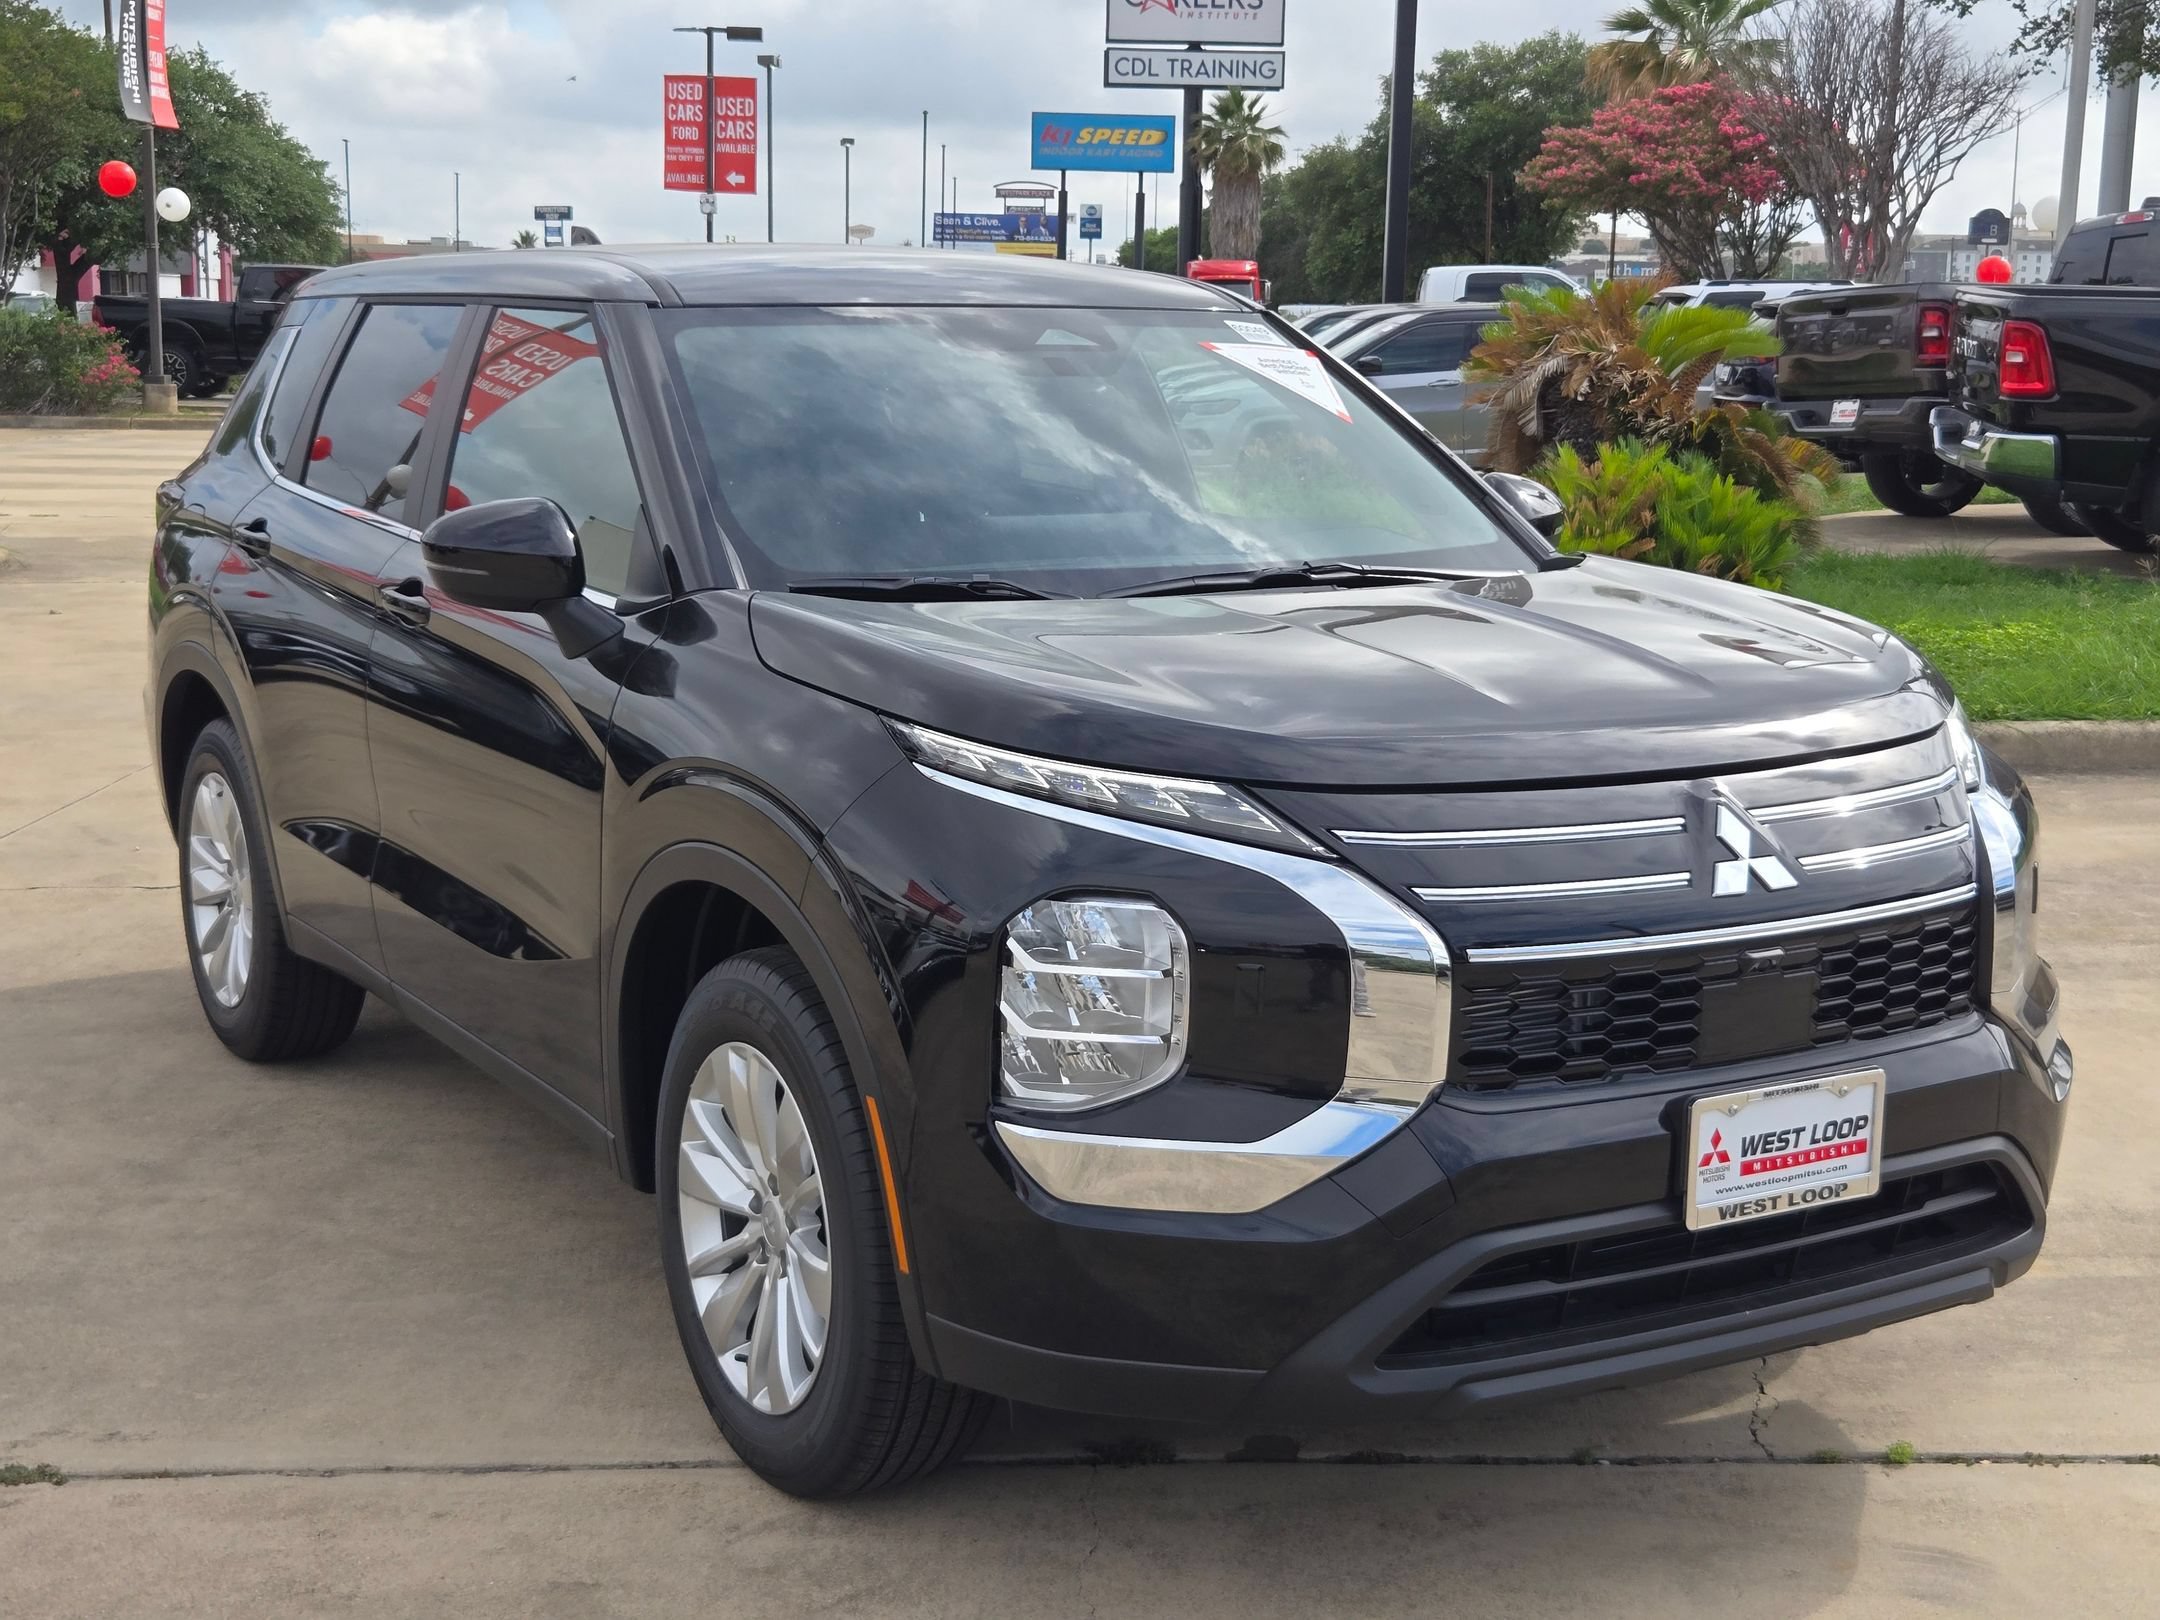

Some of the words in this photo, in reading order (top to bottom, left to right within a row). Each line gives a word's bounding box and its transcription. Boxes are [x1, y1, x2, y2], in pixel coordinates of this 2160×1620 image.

[1179, 11, 1258, 20] INSTITUTE
[122, 13, 132, 88] MOTORS
[129, 0, 141, 104] MITSUBISHI
[1114, 57, 1159, 77] CDL
[1166, 58, 1277, 79] TRAINING
[668, 83, 703, 101] USED
[668, 103, 704, 122] CARS
[716, 97, 754, 117] USED
[672, 126, 699, 140] FORD
[716, 120, 755, 140] CARS
[1041, 124, 1072, 145] K1
[1076, 127, 1168, 146] SPEED
[716, 143, 755, 154] AVAILABLE
[666, 173, 705, 184] AVAILABLE
[963, 216, 971, 226] &
[1763, 1083, 1820, 1098] MITSUBISHI
[1741, 1126, 1806, 1158] WEST
[1809, 1114, 1869, 1145] LOOP
[1752, 1143, 1857, 1171] MITSUBISHI
[1698, 1165, 1731, 1177] MITSUBISHI
[1702, 1173, 1726, 1184] MOTORS
[1715, 1163, 1848, 1195] www.westloopmitsu.com
[1718, 1195, 1782, 1220] WEST
[1788, 1182, 1848, 1207] LOOP
